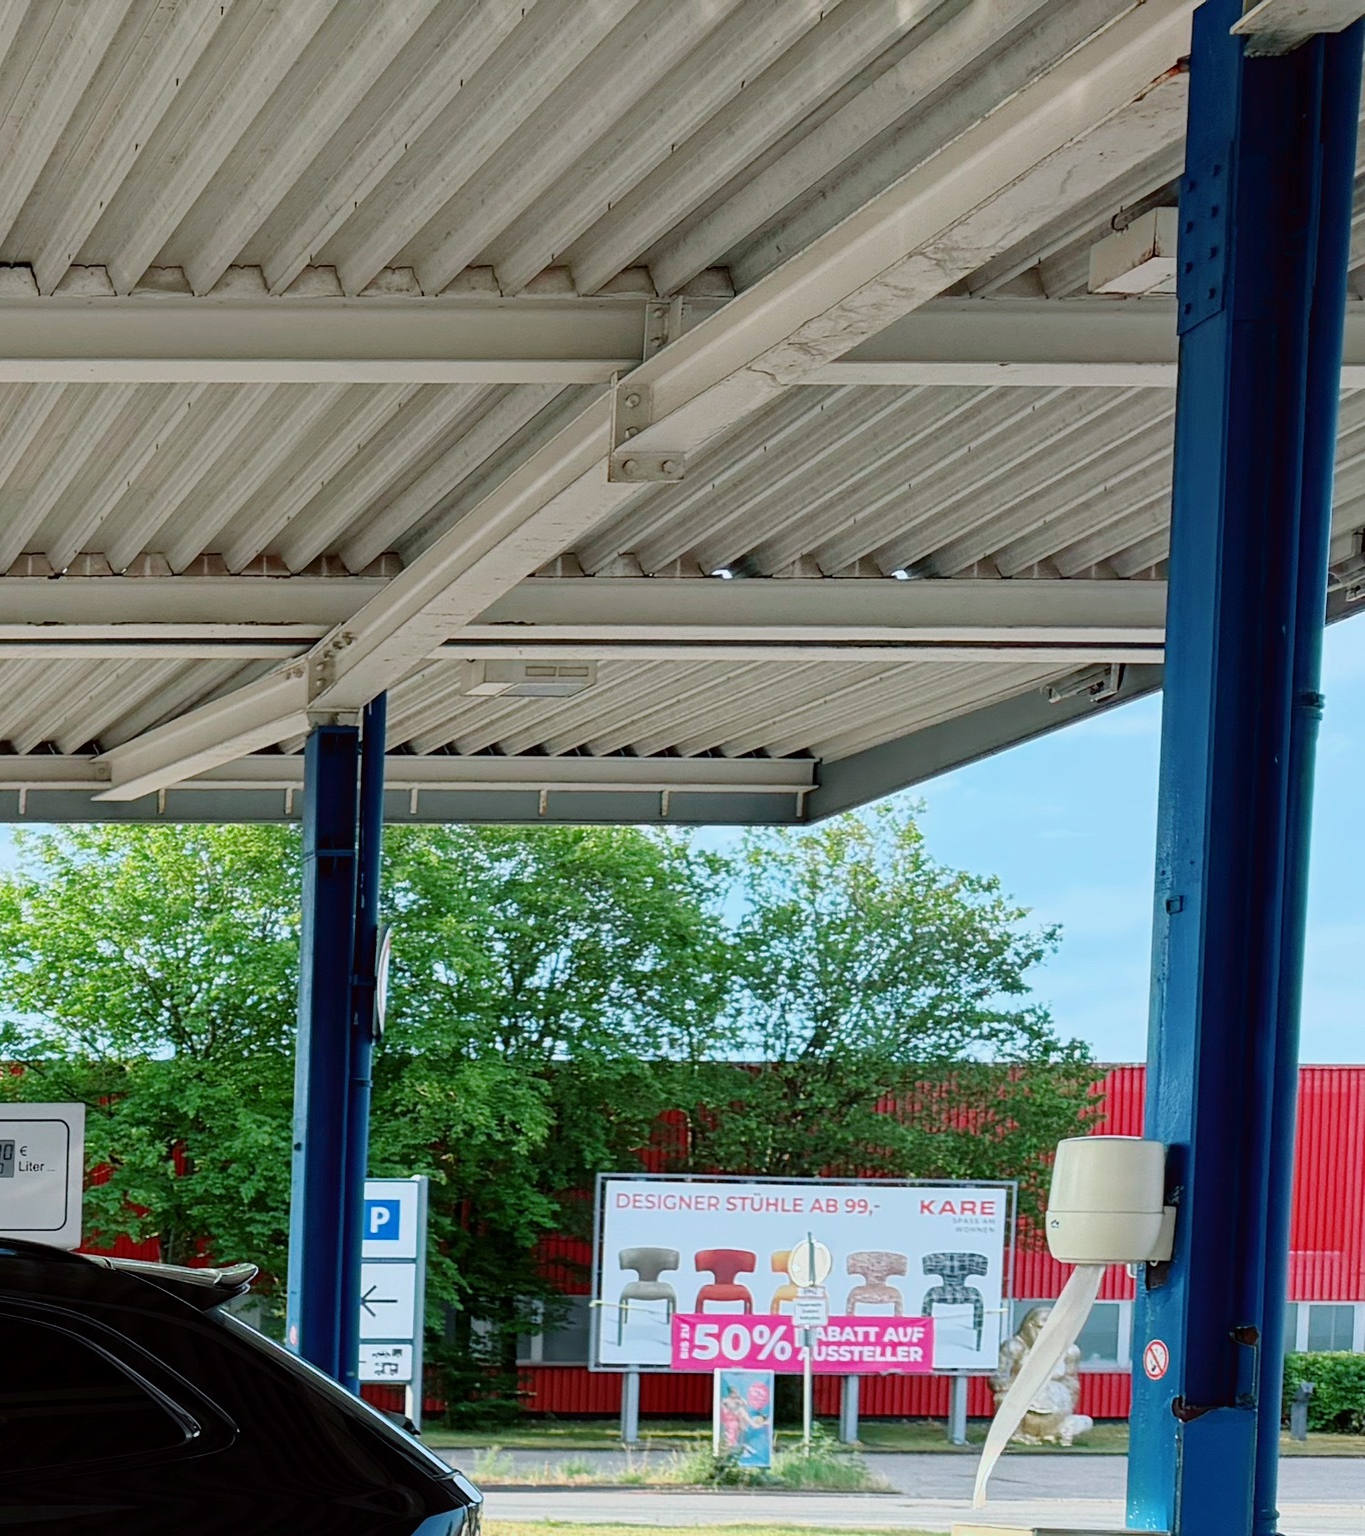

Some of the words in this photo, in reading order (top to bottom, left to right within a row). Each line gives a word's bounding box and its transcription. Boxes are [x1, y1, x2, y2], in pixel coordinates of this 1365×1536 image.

[19, 1145, 28, 1157] €
[18, 1161, 45, 1172] Liter
[616, 1193, 719, 1211] DESIGNER
[726, 1193, 804, 1213] STÜHLE
[809, 1198, 838, 1213] AB
[844, 1198, 881, 1217] 99,-
[920, 1200, 996, 1215] KARE
[370, 1206, 390, 1233] P
[679, 1324, 690, 1339] ZU
[798, 1326, 880, 1342] ABATT
[882, 1327, 925, 1342] AUF
[679, 1342, 690, 1359] BIS
[692, 1324, 792, 1361] 50%
[797, 1345, 923, 1362] AUSSTELLER
